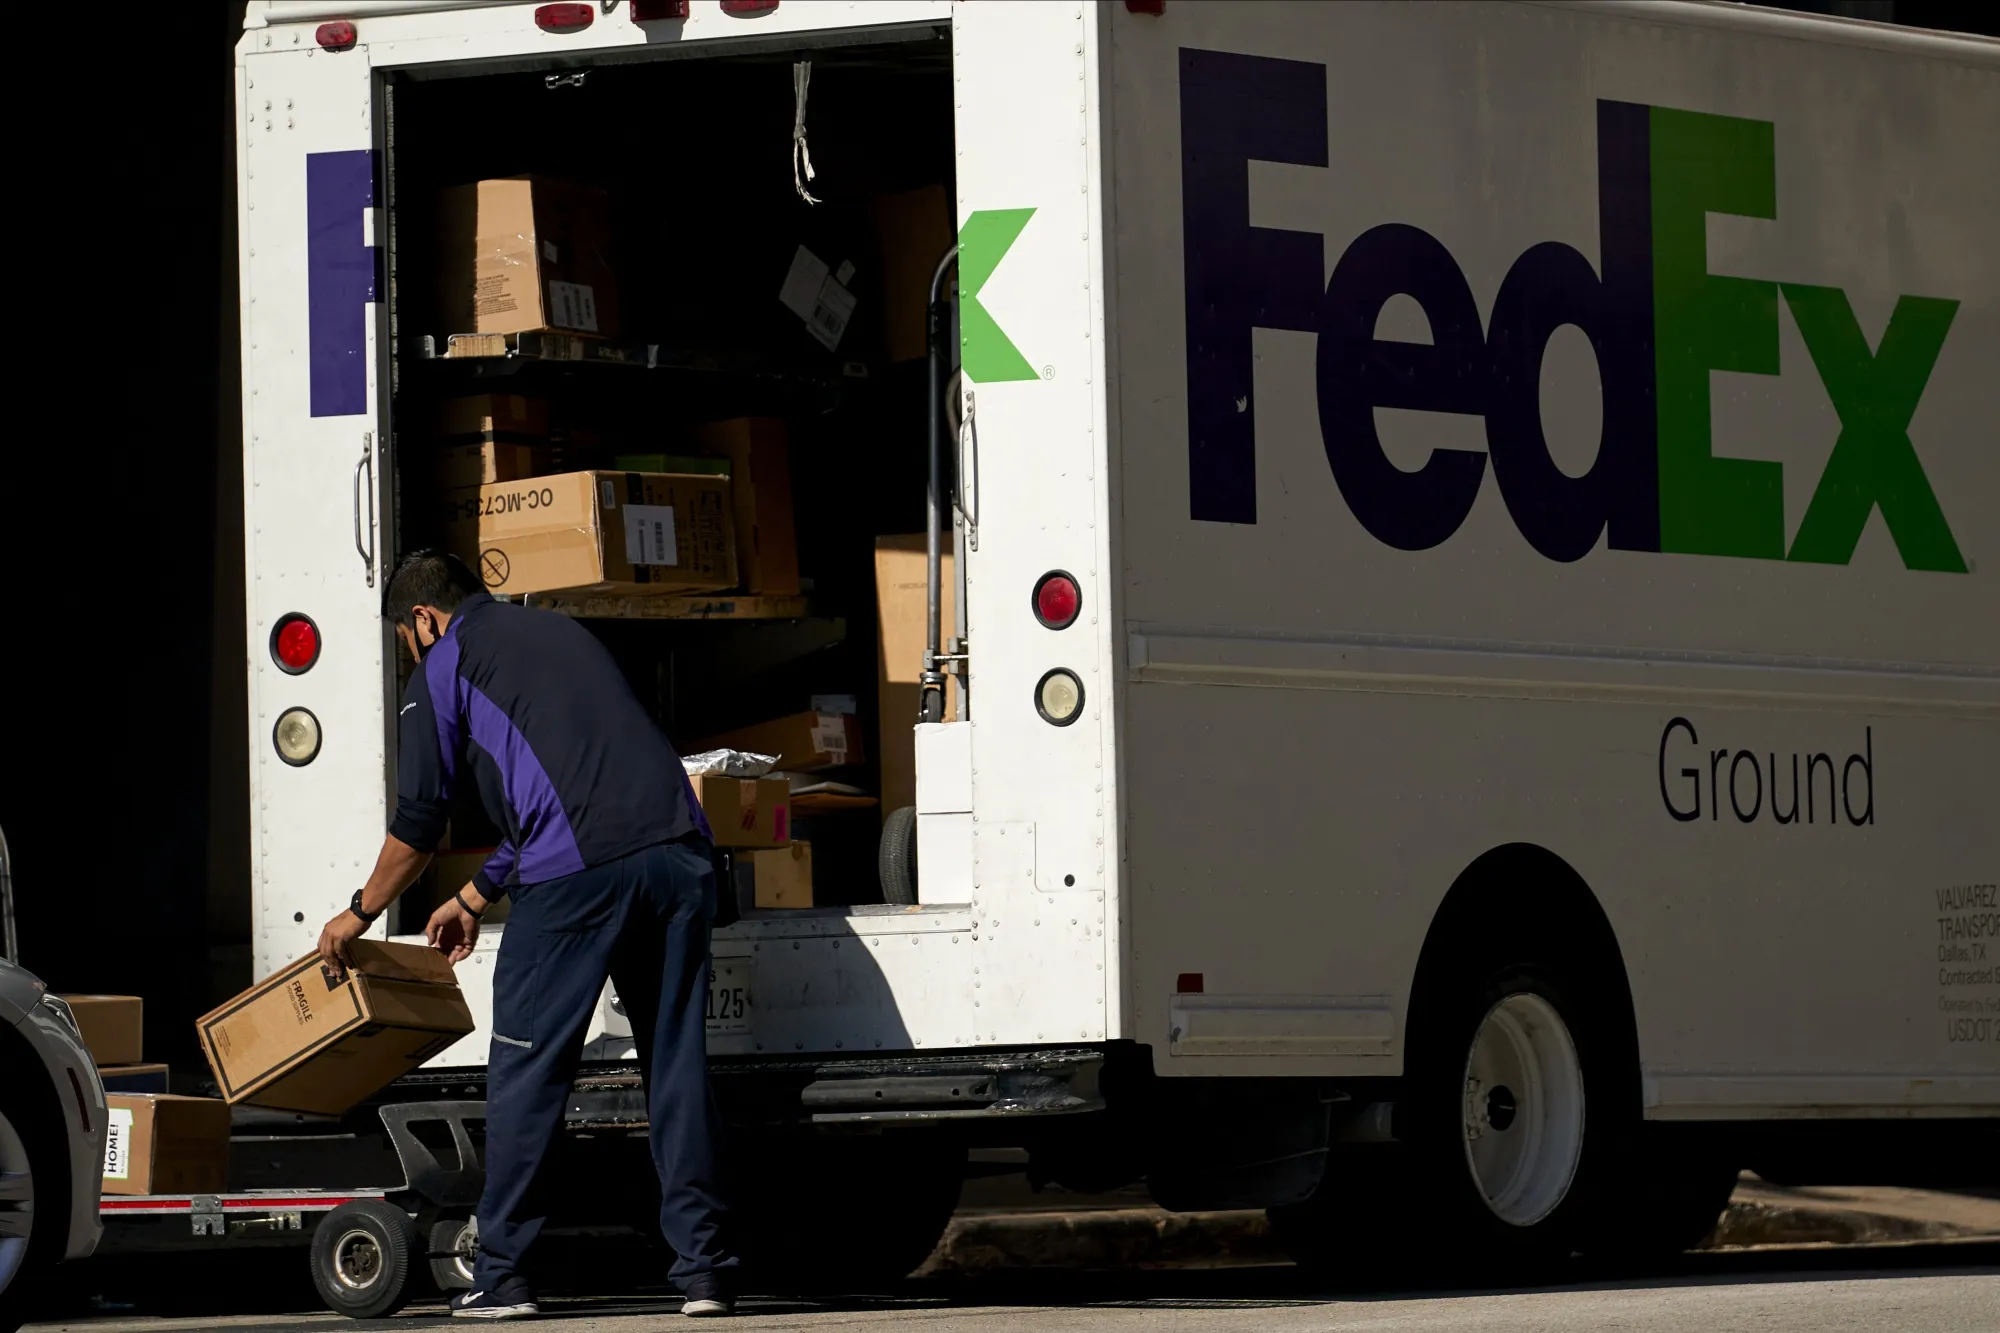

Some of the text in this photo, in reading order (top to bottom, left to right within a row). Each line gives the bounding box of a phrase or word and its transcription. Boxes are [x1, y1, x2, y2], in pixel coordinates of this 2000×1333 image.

[1178, 46, 1969, 575] FedEx
[1658, 716, 1874, 827] Ground
[1936, 884, 1997, 911] VALVAREZ
[1938, 967, 1993, 986] Contracted
[292, 980, 313, 1023] FRAGILE
[1947, 1018, 1993, 1042] USDOT
[107, 1124, 119, 1173] HOME!
